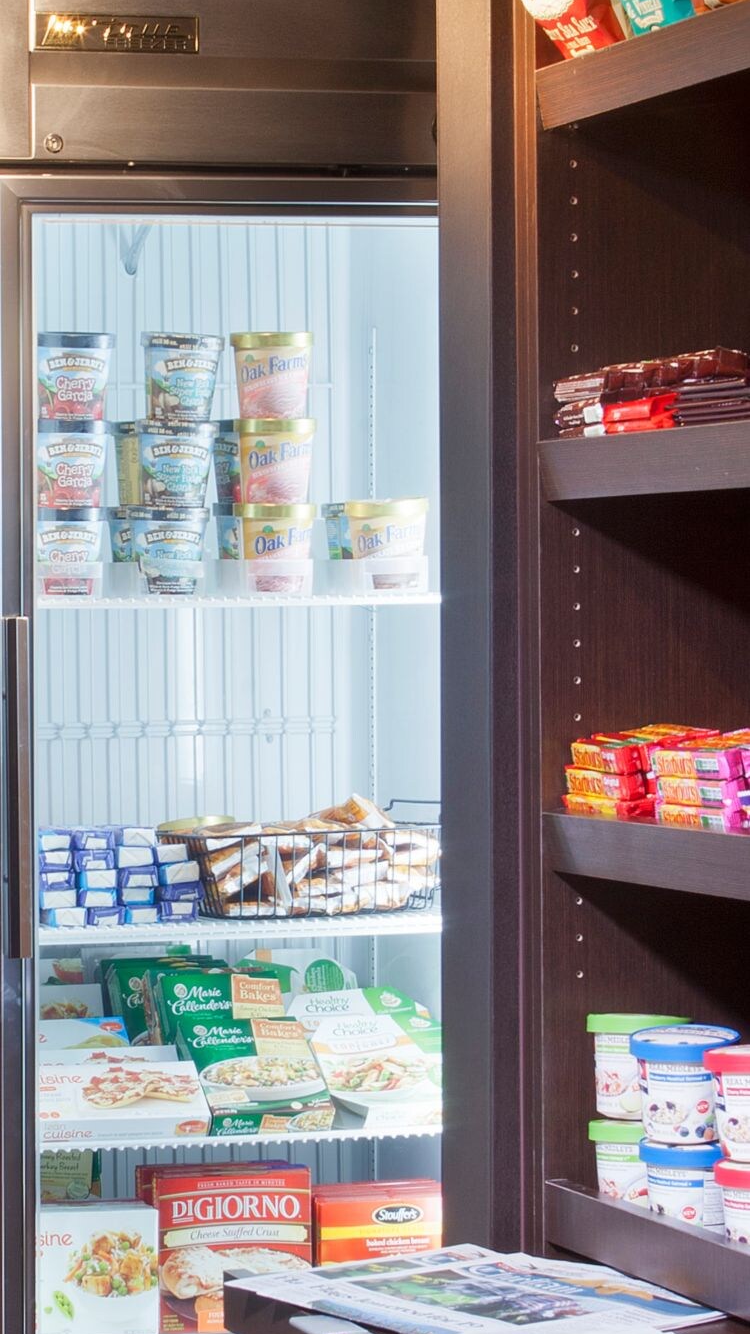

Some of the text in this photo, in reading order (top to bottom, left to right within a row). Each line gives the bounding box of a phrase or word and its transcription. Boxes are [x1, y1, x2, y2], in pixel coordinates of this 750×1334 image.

[240, 363, 267, 383] Oak
[56, 376, 95, 391] Cherry
[57, 389, 94, 402] Garcia
[249, 450, 278, 471] Oak
[56, 463, 94, 476] Cherry
[57, 475, 93, 488] Garcia
[255, 535, 285, 555] Oak
[357, 534, 383, 553] Oak
[50, 550, 88, 563] Cherry
[239, 981, 275, 992] Comfort
[184, 986, 222, 1003] Marie
[240, 989, 277, 1003] Bakes
[167, 998, 231, 1016] Callender's
[305, 1003, 350, 1013] Choice
[206, 1026, 243, 1038] Marie
[259, 1022, 296, 1031] Comfort
[261, 1028, 299, 1038] Bakes
[332, 1026, 379, 1037] Choice
[40, 1073, 84, 1085] isine
[43, 1129, 93, 1140] cuisine
[378, 1207, 418, 1223] Stouffer's
[40, 1231, 73, 1247] sine
[190, 1226, 280, 1241] Cheese Stuffed Crust
